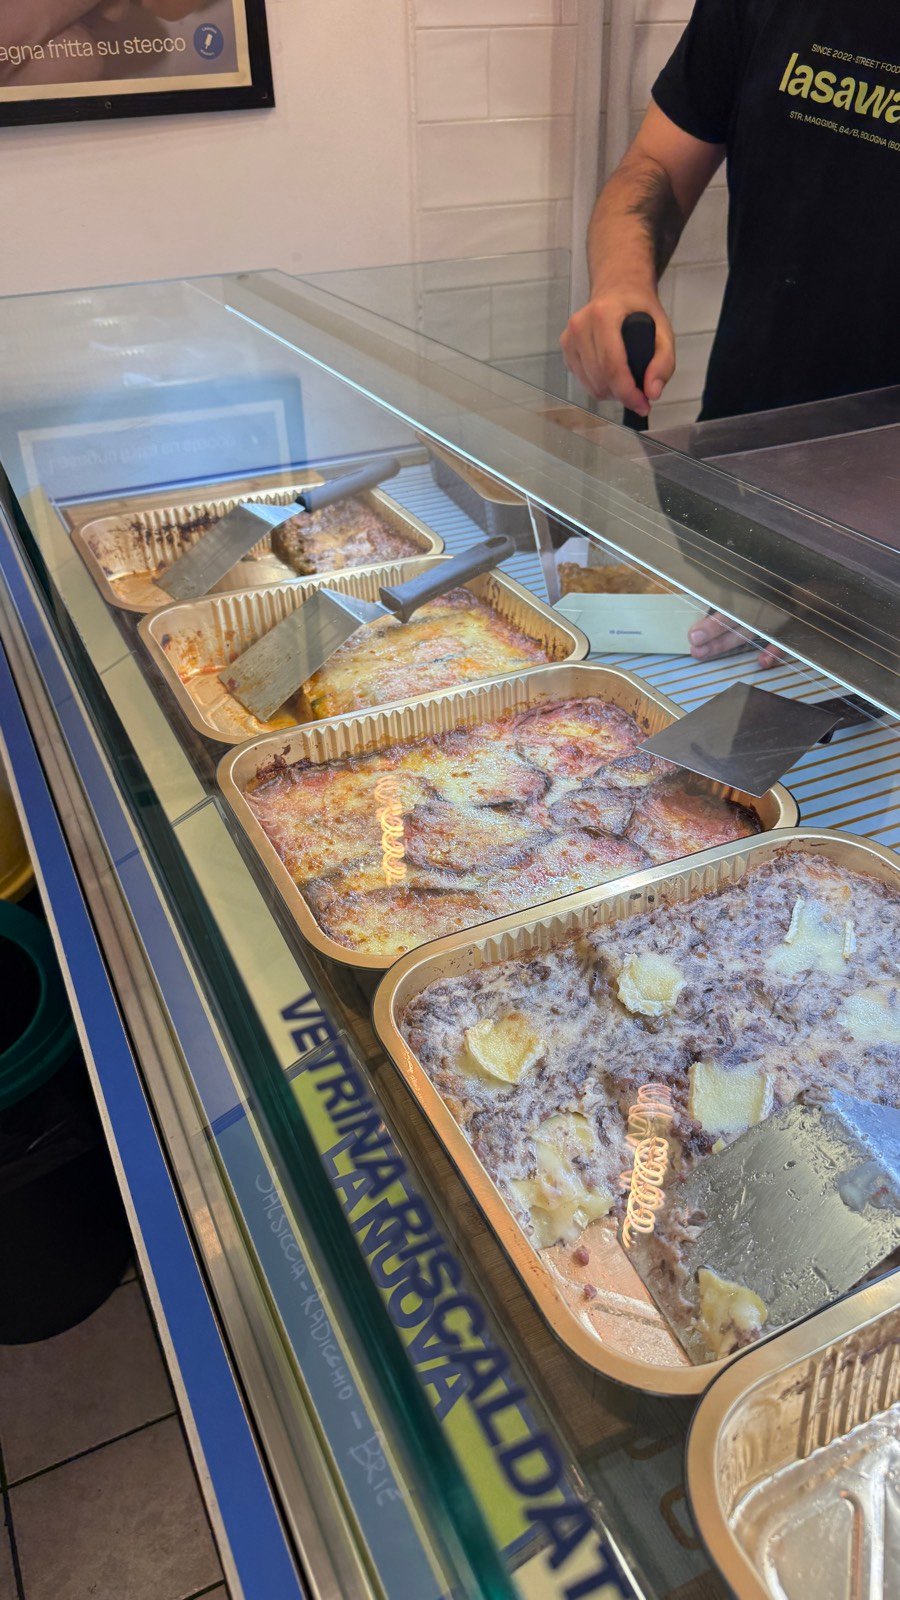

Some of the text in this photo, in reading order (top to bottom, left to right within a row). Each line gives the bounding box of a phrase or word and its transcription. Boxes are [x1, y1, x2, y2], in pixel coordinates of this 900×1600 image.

[47, 39, 93, 58] fritta
[97, 41, 119, 56] su
[123, 36, 186, 54] stecco
[811, 43, 833, 56] SINCE
[832, 50, 853, 62] 2022
[860, 130, 887, 146] BOLOGNA
[280, 992, 407, 1200] VETRINA
[347, 1430, 406, 1508] BRIE
